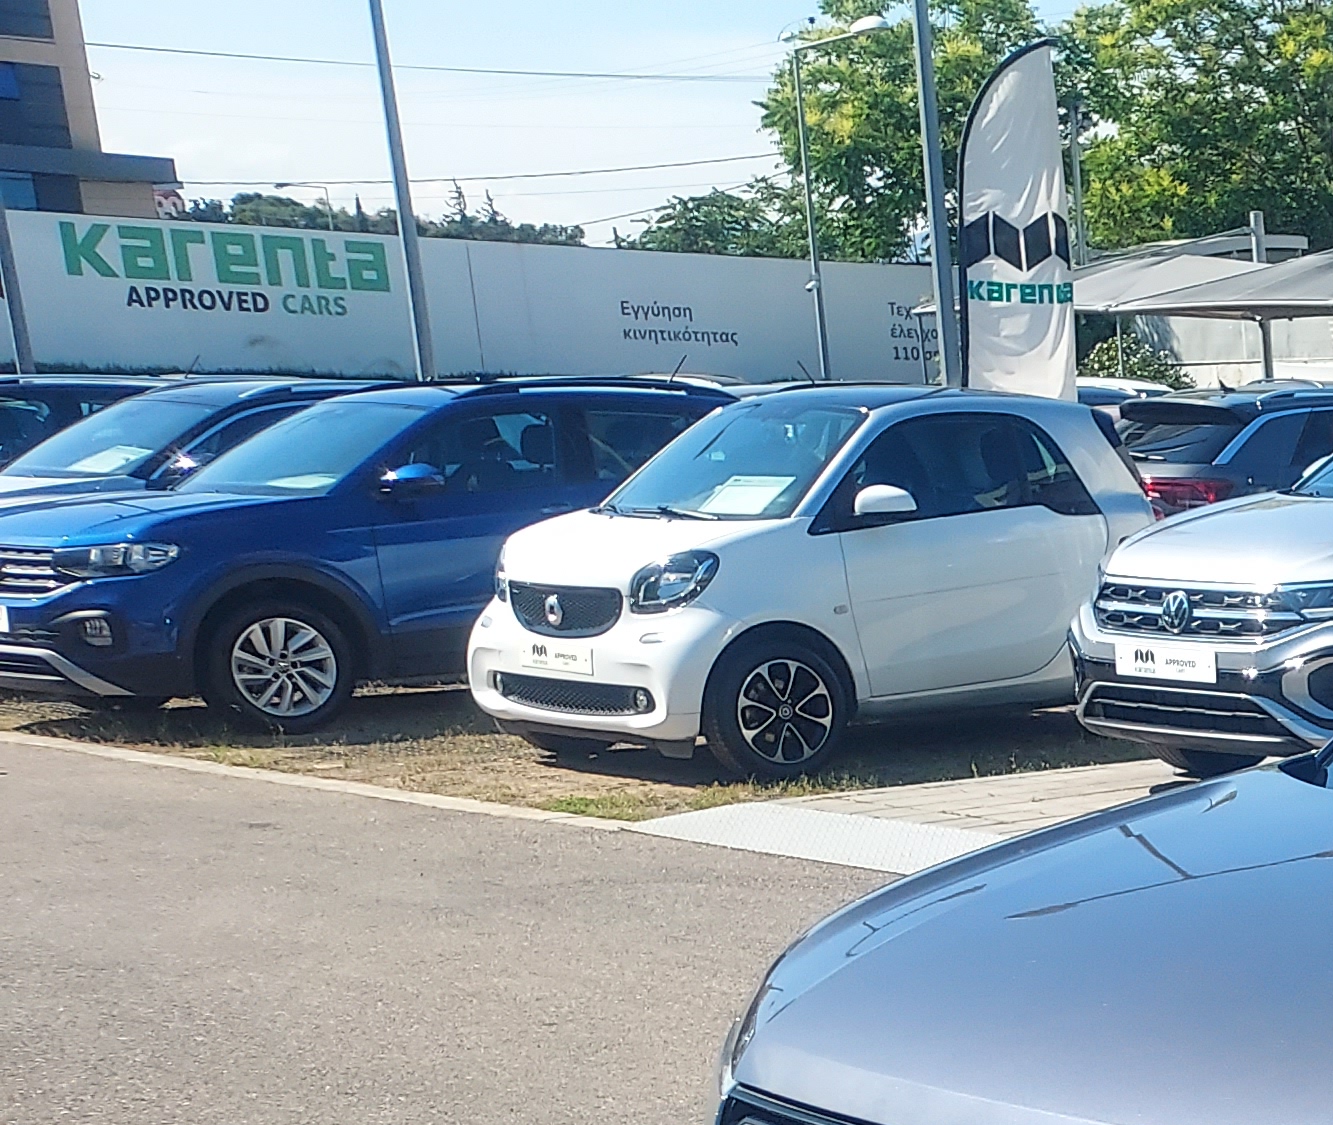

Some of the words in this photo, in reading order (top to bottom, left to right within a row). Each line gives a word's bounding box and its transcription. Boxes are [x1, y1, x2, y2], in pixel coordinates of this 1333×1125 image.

[126, 285, 270, 314] APPROVED
[281, 293, 348, 317] CARS
[620, 300, 693, 322] Εγγύηση
[888, 302, 913, 320] Τεχ
[623, 326, 739, 347] κινητικότητας
[891, 324, 939, 343] έλεγχο
[893, 346, 920, 361] 110
